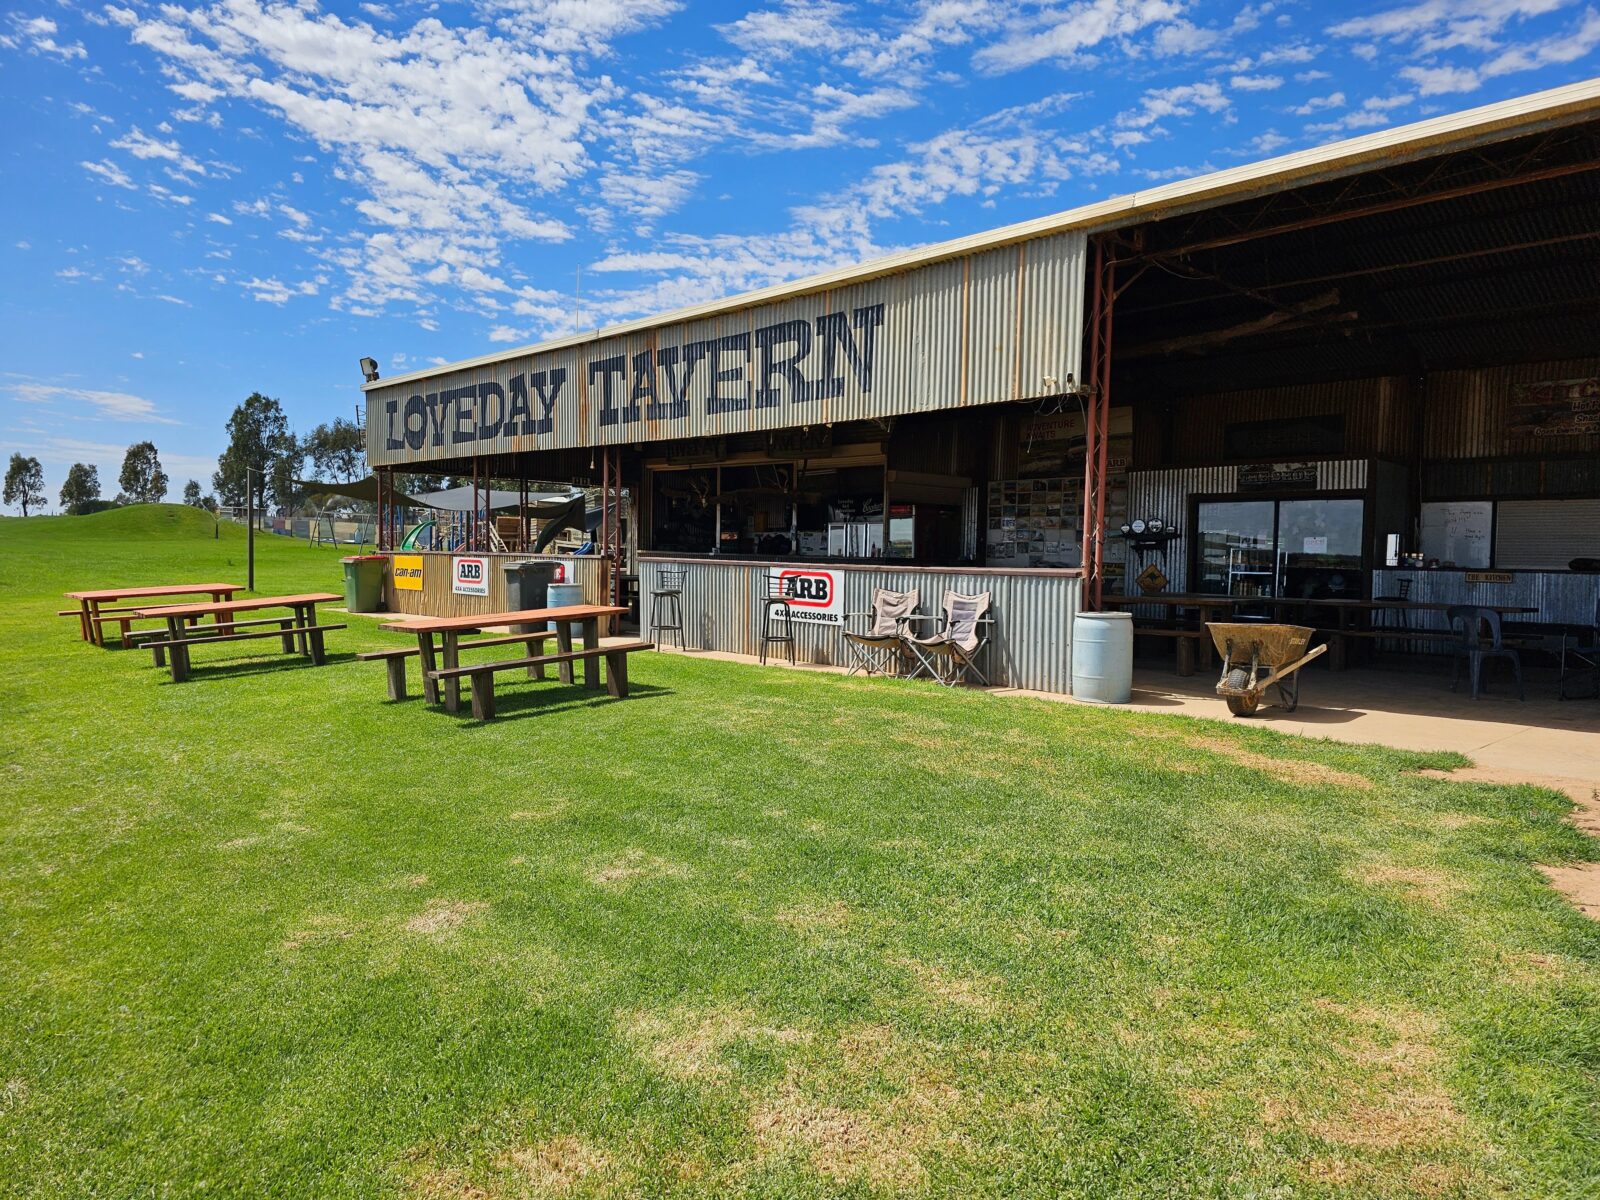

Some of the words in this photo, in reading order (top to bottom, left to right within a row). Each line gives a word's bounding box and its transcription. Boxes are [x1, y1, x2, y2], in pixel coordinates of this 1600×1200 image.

[386, 367, 567, 451] LOVEDAY
[588, 304, 885, 427] TAVERN
[1025, 419, 1075, 431] ADVENTURE
[1026, 430, 1056, 440] AWAITS
[395, 568, 422, 578] can-am
[460, 564, 480, 579] ARB
[463, 586, 486, 594] ACCESSORIES
[785, 576, 828, 601] ARB
[791, 610, 839, 622] ACCESSORIES
